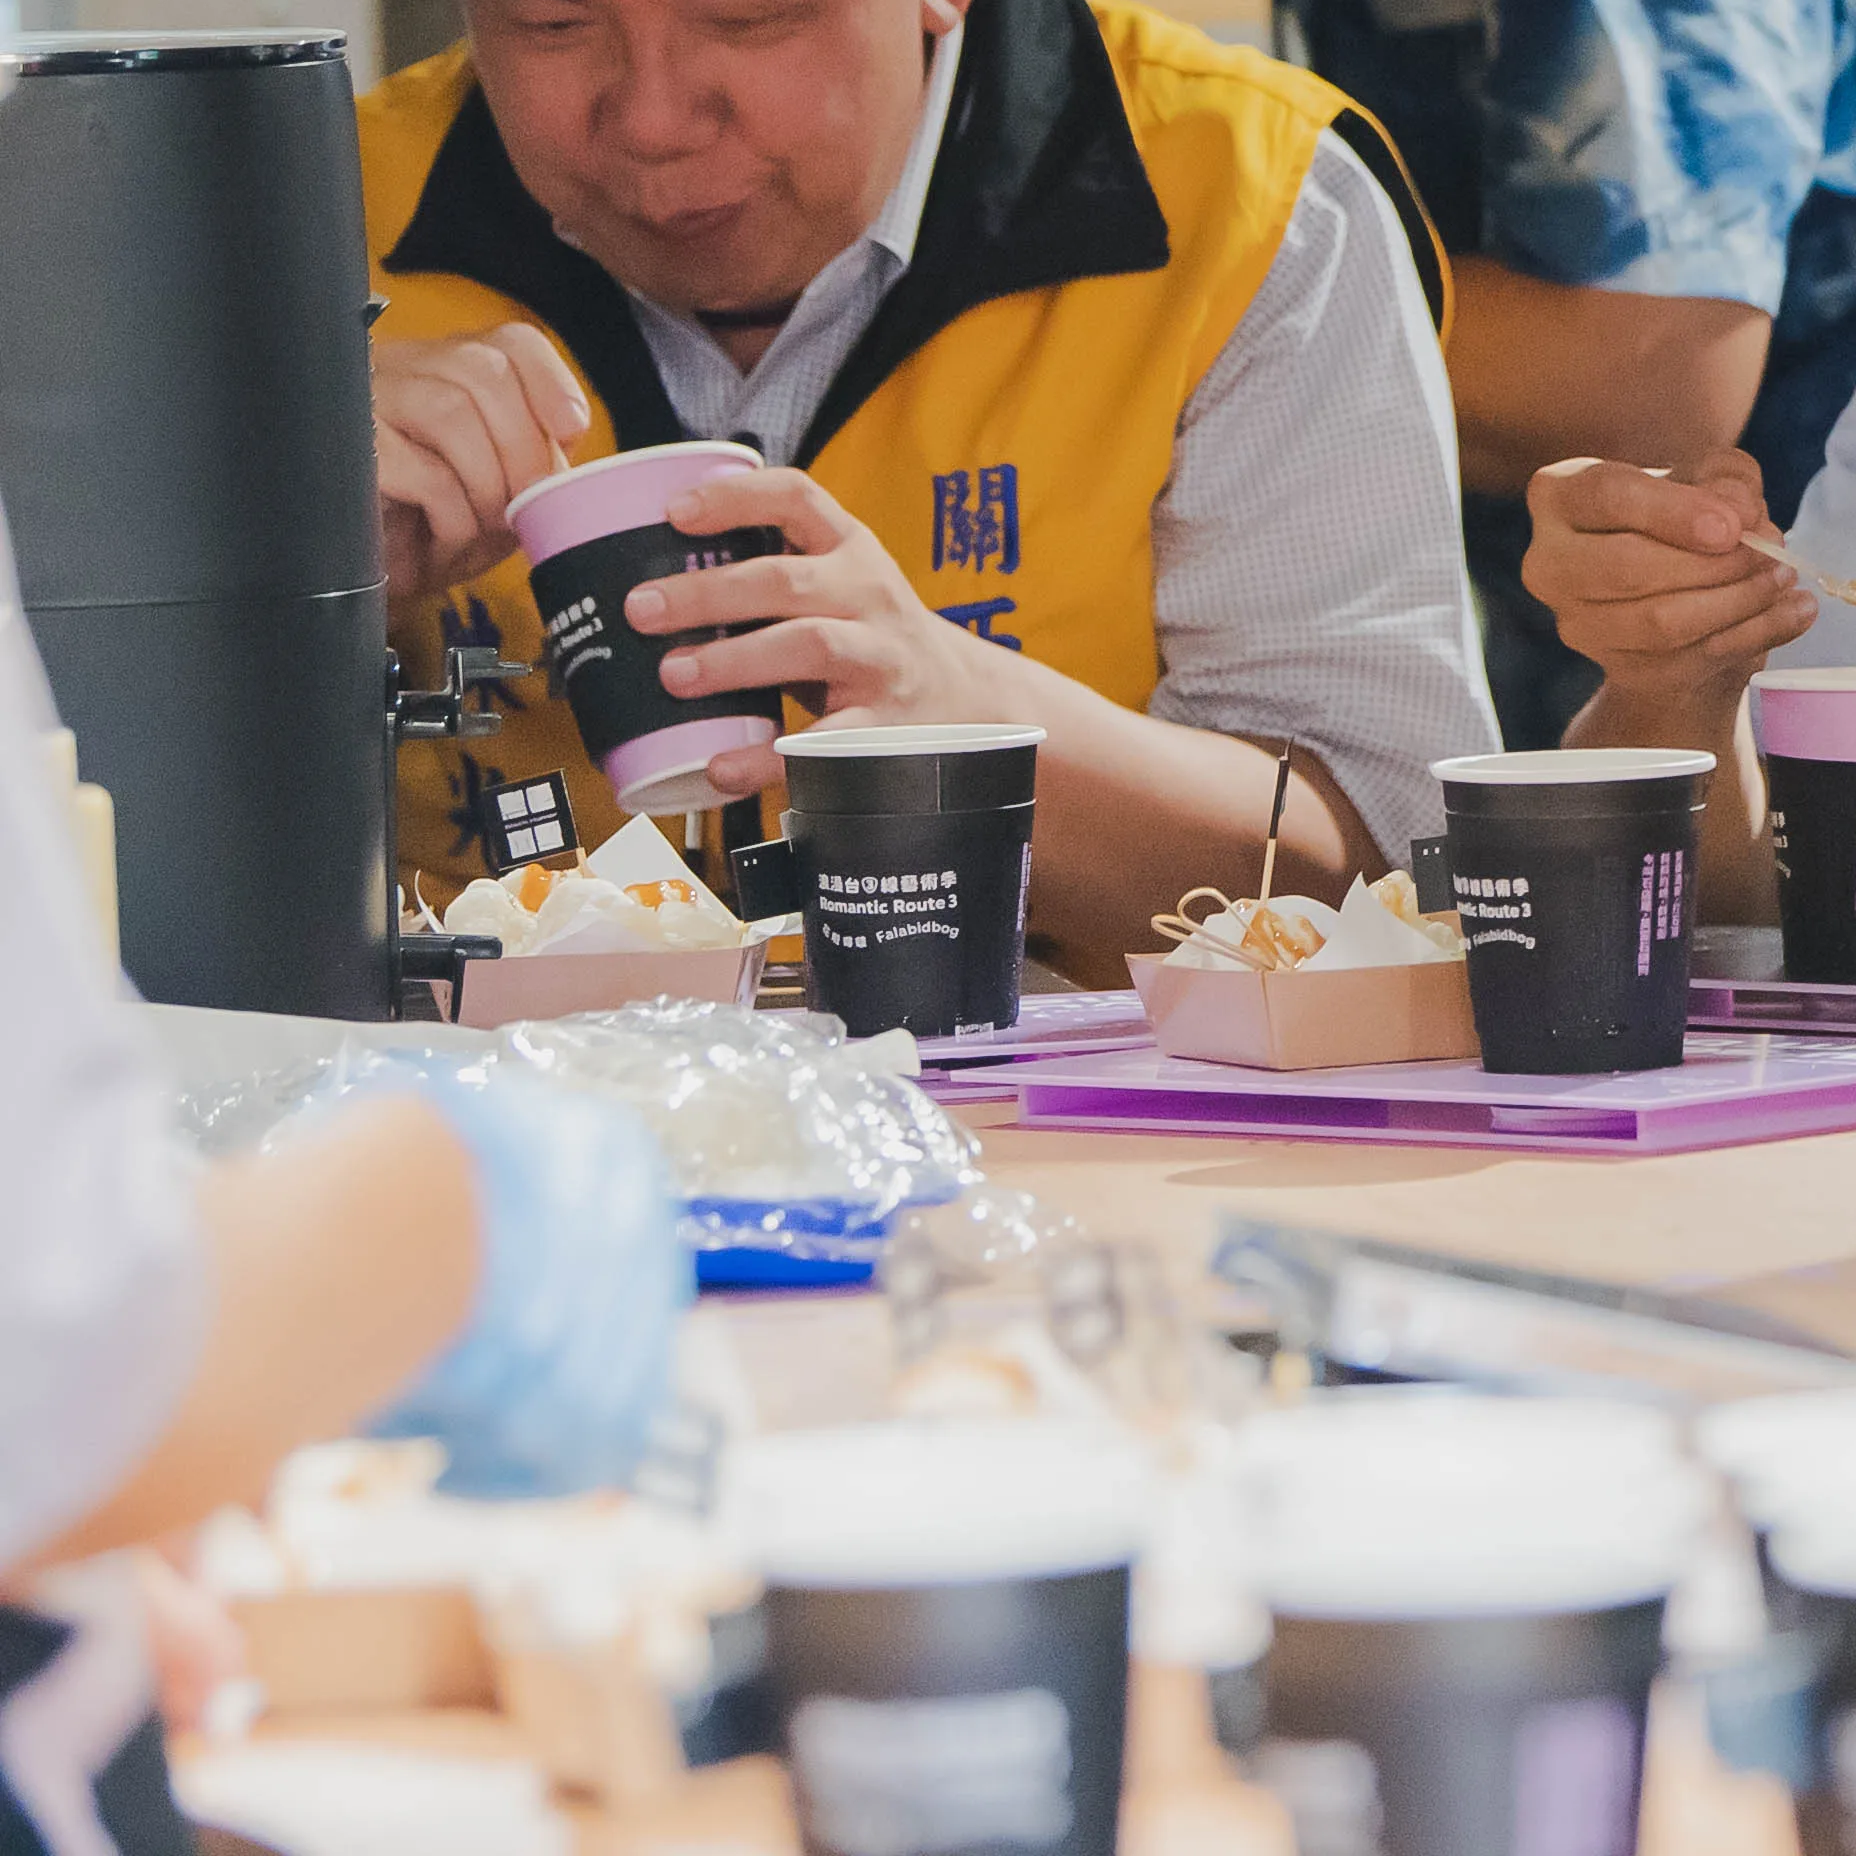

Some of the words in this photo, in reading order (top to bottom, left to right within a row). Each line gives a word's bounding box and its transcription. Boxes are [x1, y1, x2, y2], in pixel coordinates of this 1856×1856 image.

[819, 895, 889, 915] Romantic
[892, 897, 946, 914] Route
[947, 893, 958, 908] 3
[1478, 902, 1520, 918] Route
[1521, 902, 1532, 918] 3
[875, 920, 960, 944] Falabidbog
